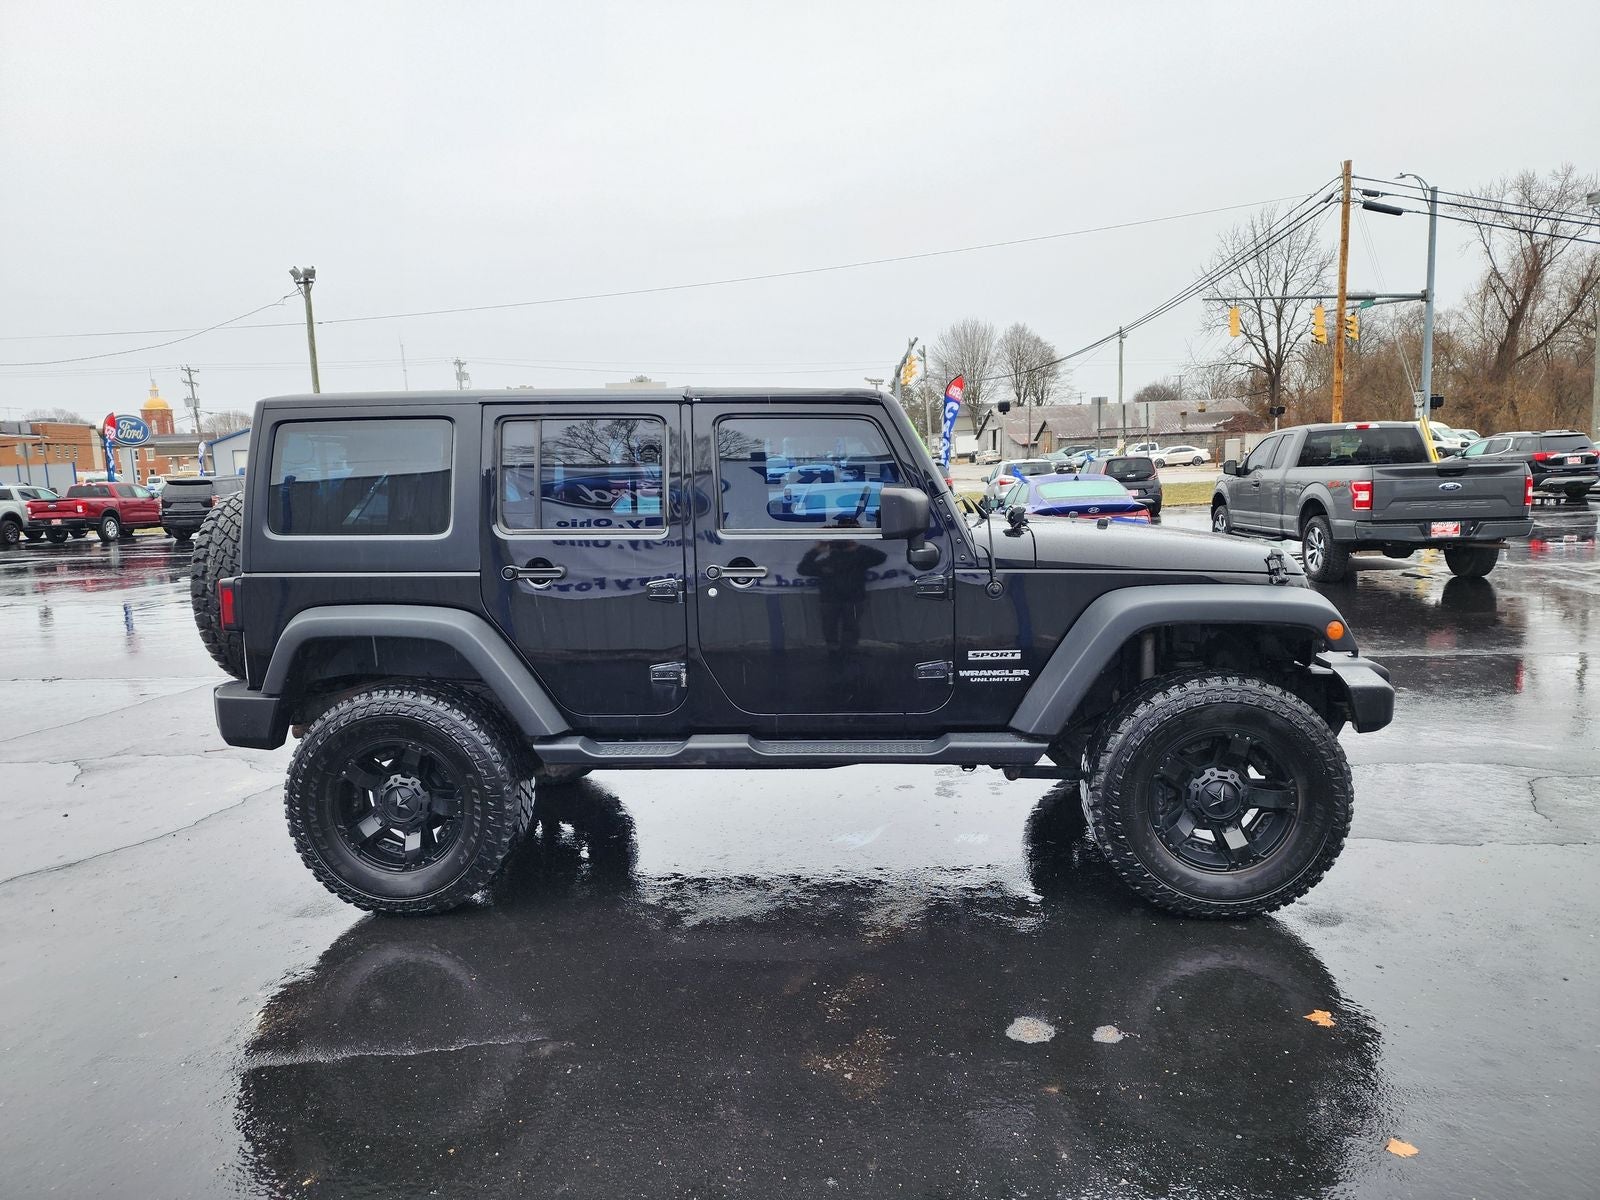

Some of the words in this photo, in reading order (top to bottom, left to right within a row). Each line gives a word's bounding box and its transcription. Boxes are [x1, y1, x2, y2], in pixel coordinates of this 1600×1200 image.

[117, 419, 144, 439] Ford
[970, 651, 1019, 659] SPORT
[959, 669, 1030, 677] WRANGLER
